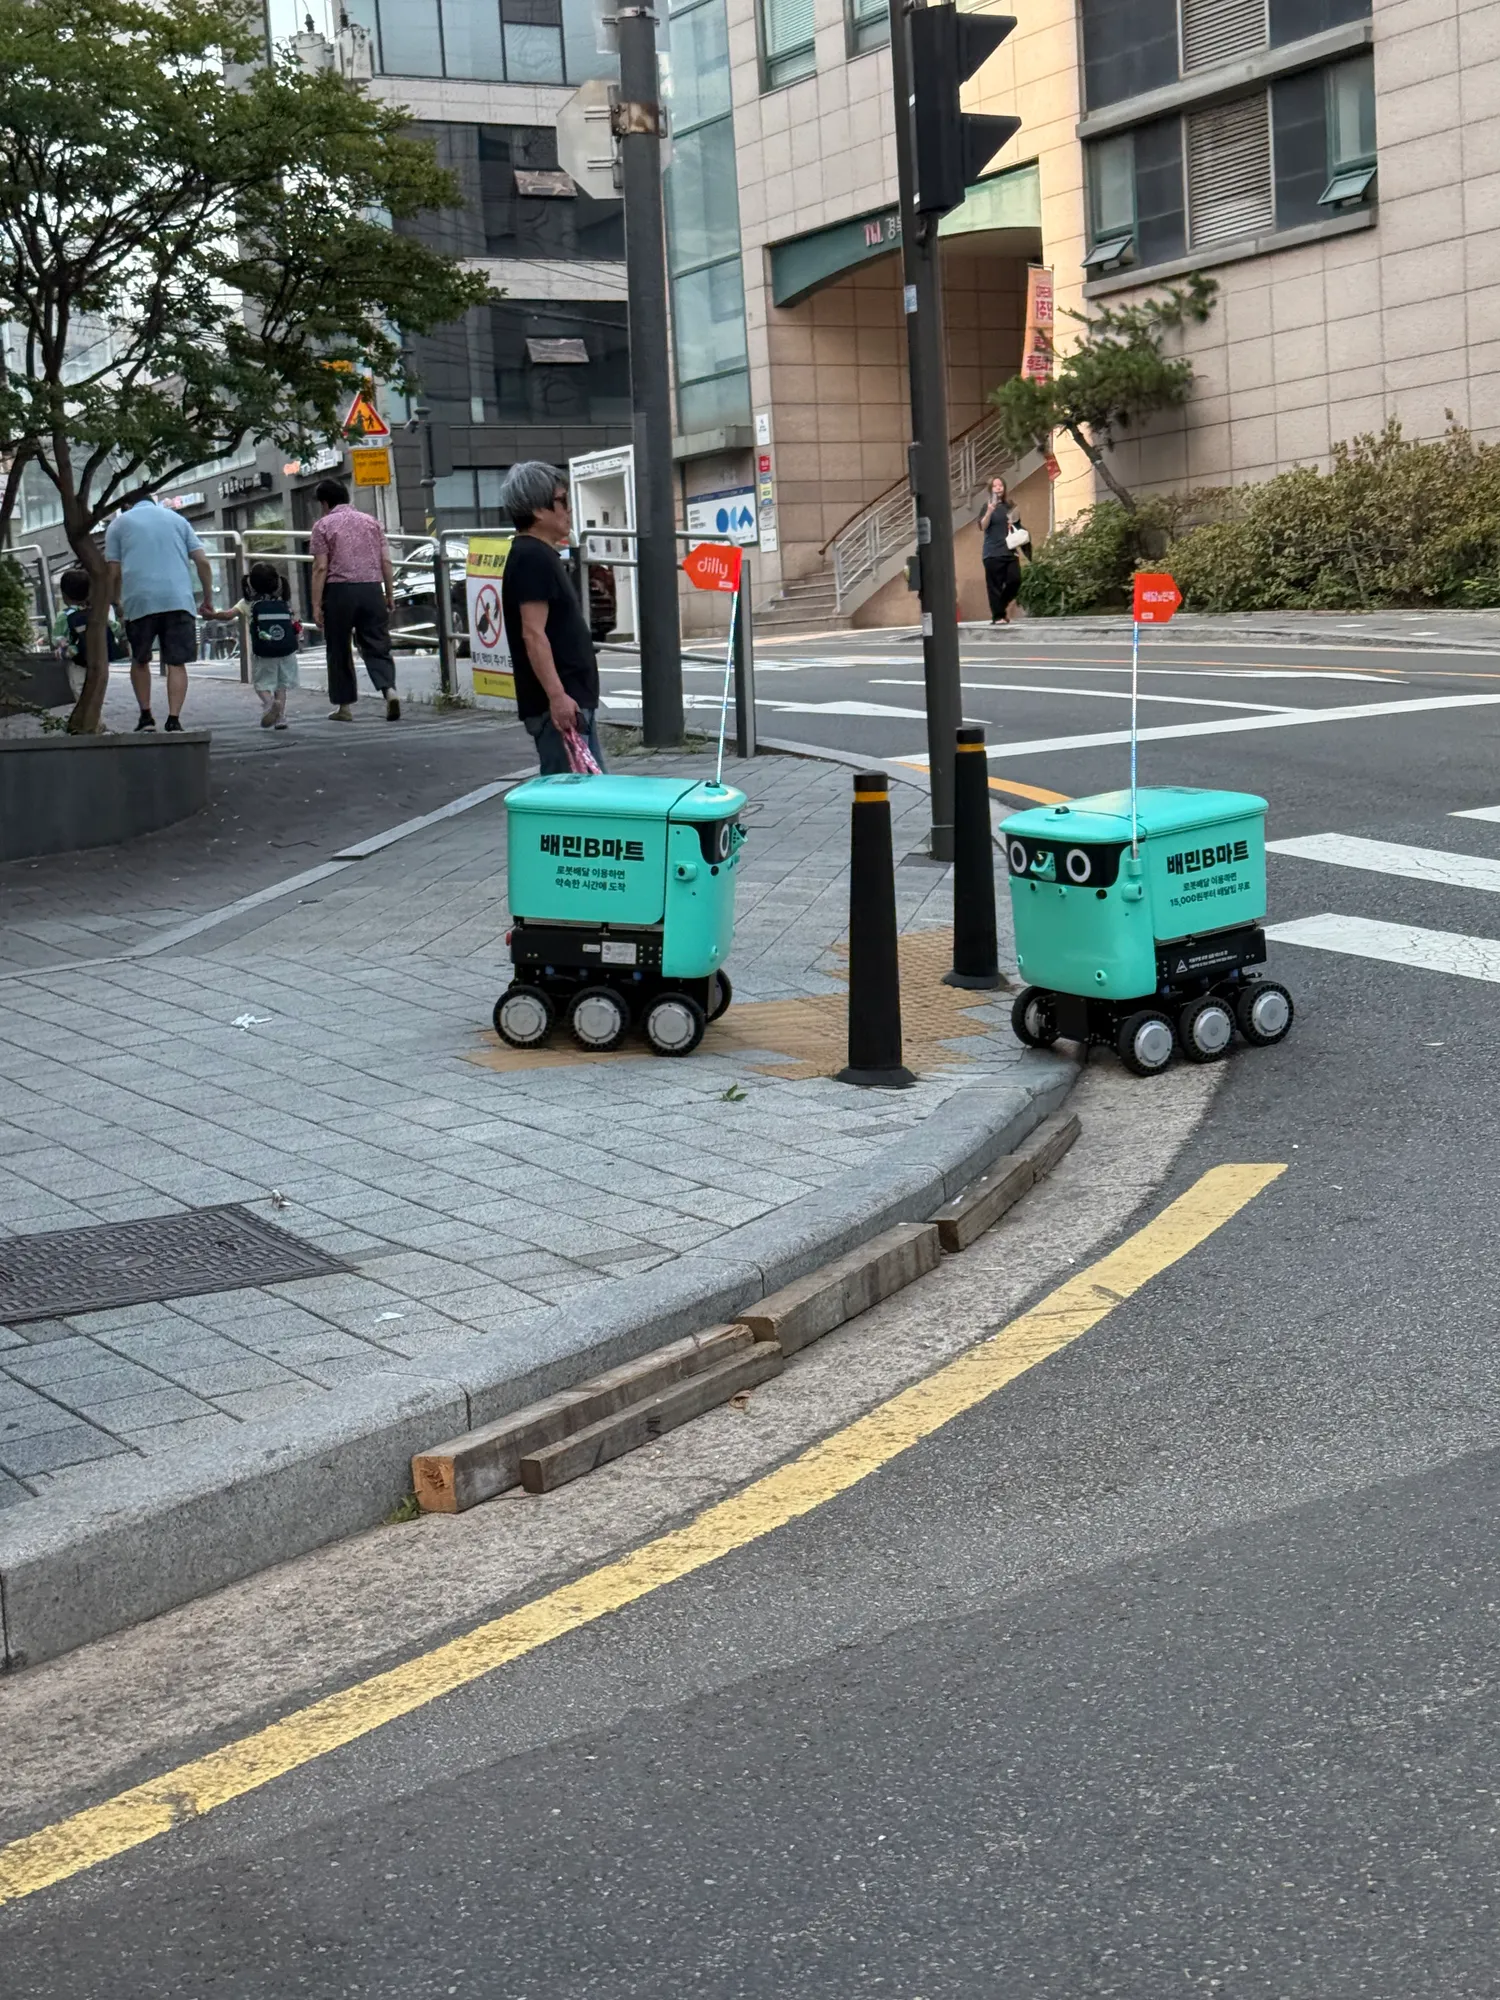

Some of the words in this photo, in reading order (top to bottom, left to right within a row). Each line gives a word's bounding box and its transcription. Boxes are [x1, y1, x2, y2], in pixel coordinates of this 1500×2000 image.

[697, 556, 728, 579] dilly
[540, 834, 644, 861] 배민B마트
[1166, 840, 1249, 874] 배민B마트
[556, 866, 590, 877] 로봇배달
[592, 868, 625, 879] 이용하면
[1183, 878, 1210, 891] 로봇배달
[1211, 872, 1237, 885] 이용하면
[555, 878, 580, 889] 약속한
[582, 880, 607, 891] 시간에
[608, 882, 626, 892] 도착
[1170, 889, 1216, 907] 15,000원부터
[1237, 881, 1251, 892] 무료
